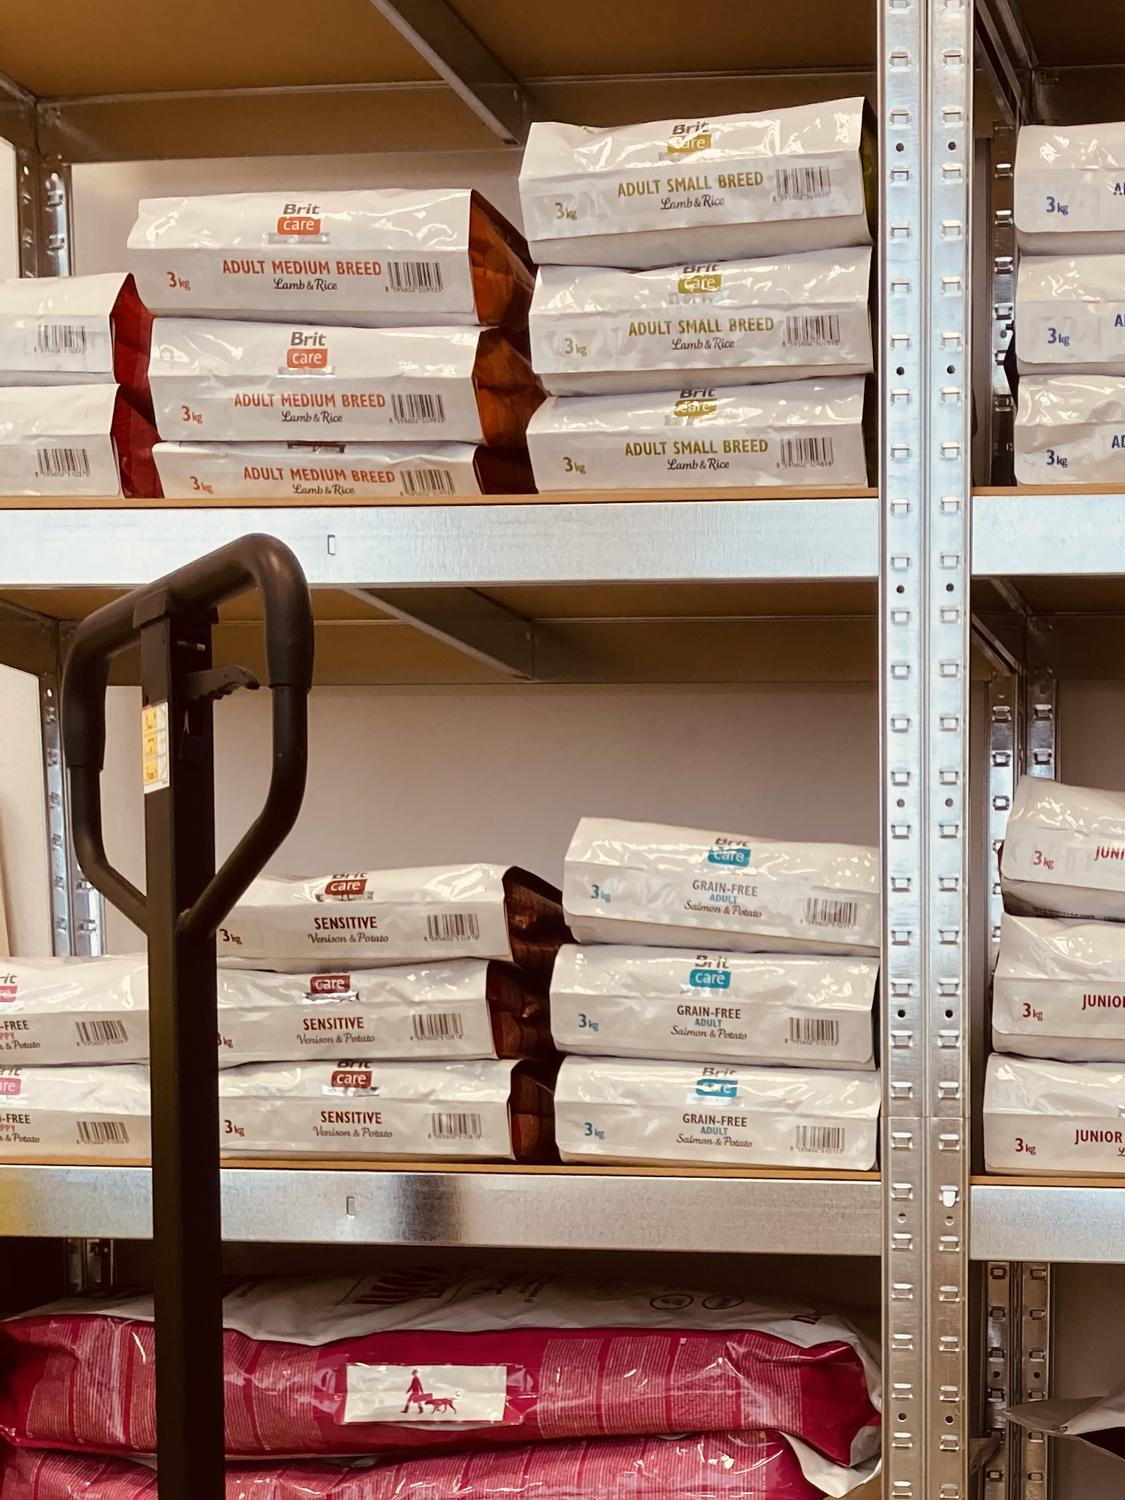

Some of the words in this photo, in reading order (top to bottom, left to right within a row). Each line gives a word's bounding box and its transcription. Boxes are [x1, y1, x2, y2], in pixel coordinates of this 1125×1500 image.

[617, 180, 660, 197] ADULT
[667, 175, 713, 193] SMALL
[718, 171, 764, 188] BREED
[283, 204, 320, 215] Brit
[283, 217, 314, 231] care
[223, 260, 265, 274] ADULT
[272, 261, 330, 275] MEDIUM
[336, 262, 381, 277] BREED
[684, 275, 715, 290] care
[629, 319, 672, 336] ADULT
[678, 318, 721, 335] SMALL
[729, 317, 774, 333] BREED
[290, 332, 327, 346] Brit
[292, 352, 322, 365] care
[234, 394, 274, 407] ADULT
[281, 394, 336, 407] MEDIUM
[342, 395, 385, 408] BREED
[625, 442, 667, 456] ADULT
[673, 441, 717, 455] SMALL
[723, 439, 768, 453] BREED
[244, 466, 284, 480] ADULT
[290, 468, 346, 481] MEDIUM
[352, 470, 395, 483] BREED
[330, 881, 361, 891] care
[692, 879, 758, 897] GRAIN-FREE
[710, 893, 738, 905] ADULT
[314, 917, 377, 929] SENSITIVE
[308, 933, 347, 943] Venison
[358, 933, 389, 943] Potato
[315, 979, 345, 990] care
[695, 972, 724, 984] care
[677, 1005, 742, 1020] GRAIN-FREE
[303, 1017, 364, 1030] SENSITIVE
[695, 1018, 722, 1028] ADULT
[670, 1025, 707, 1039] Salmon
[718, 1030, 747, 1041] Potato
[336, 1073, 366, 1085] care
[321, 1111, 382, 1124] SENSITIVE
[682, 1113, 747, 1127] GRAIN-FREE
[700, 1126, 728, 1136] ADULT
[1074, 1129, 1123, 1145] JUNIOR
